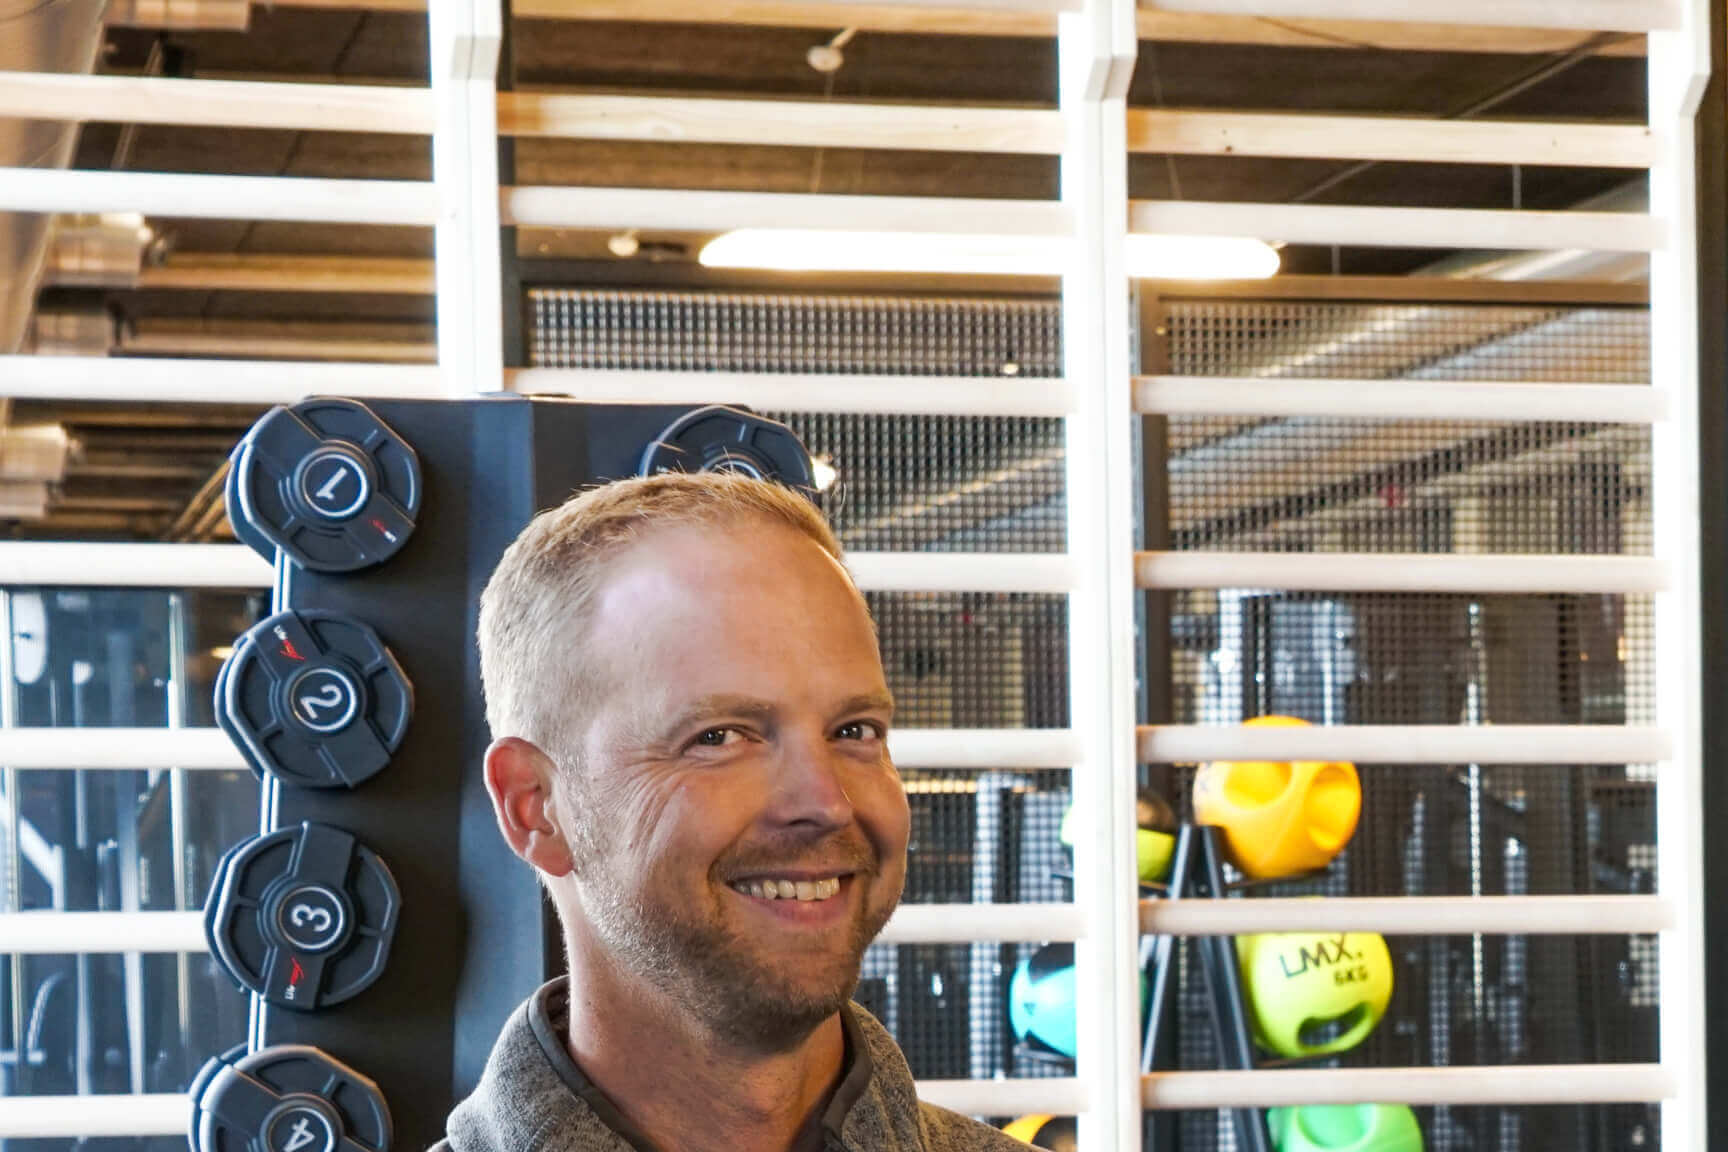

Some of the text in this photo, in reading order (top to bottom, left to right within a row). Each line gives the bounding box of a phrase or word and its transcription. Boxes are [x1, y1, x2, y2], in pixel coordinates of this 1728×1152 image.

[316, 467, 348, 500] 1
[300, 684, 343, 720] 2
[291, 904, 331, 932] 3
